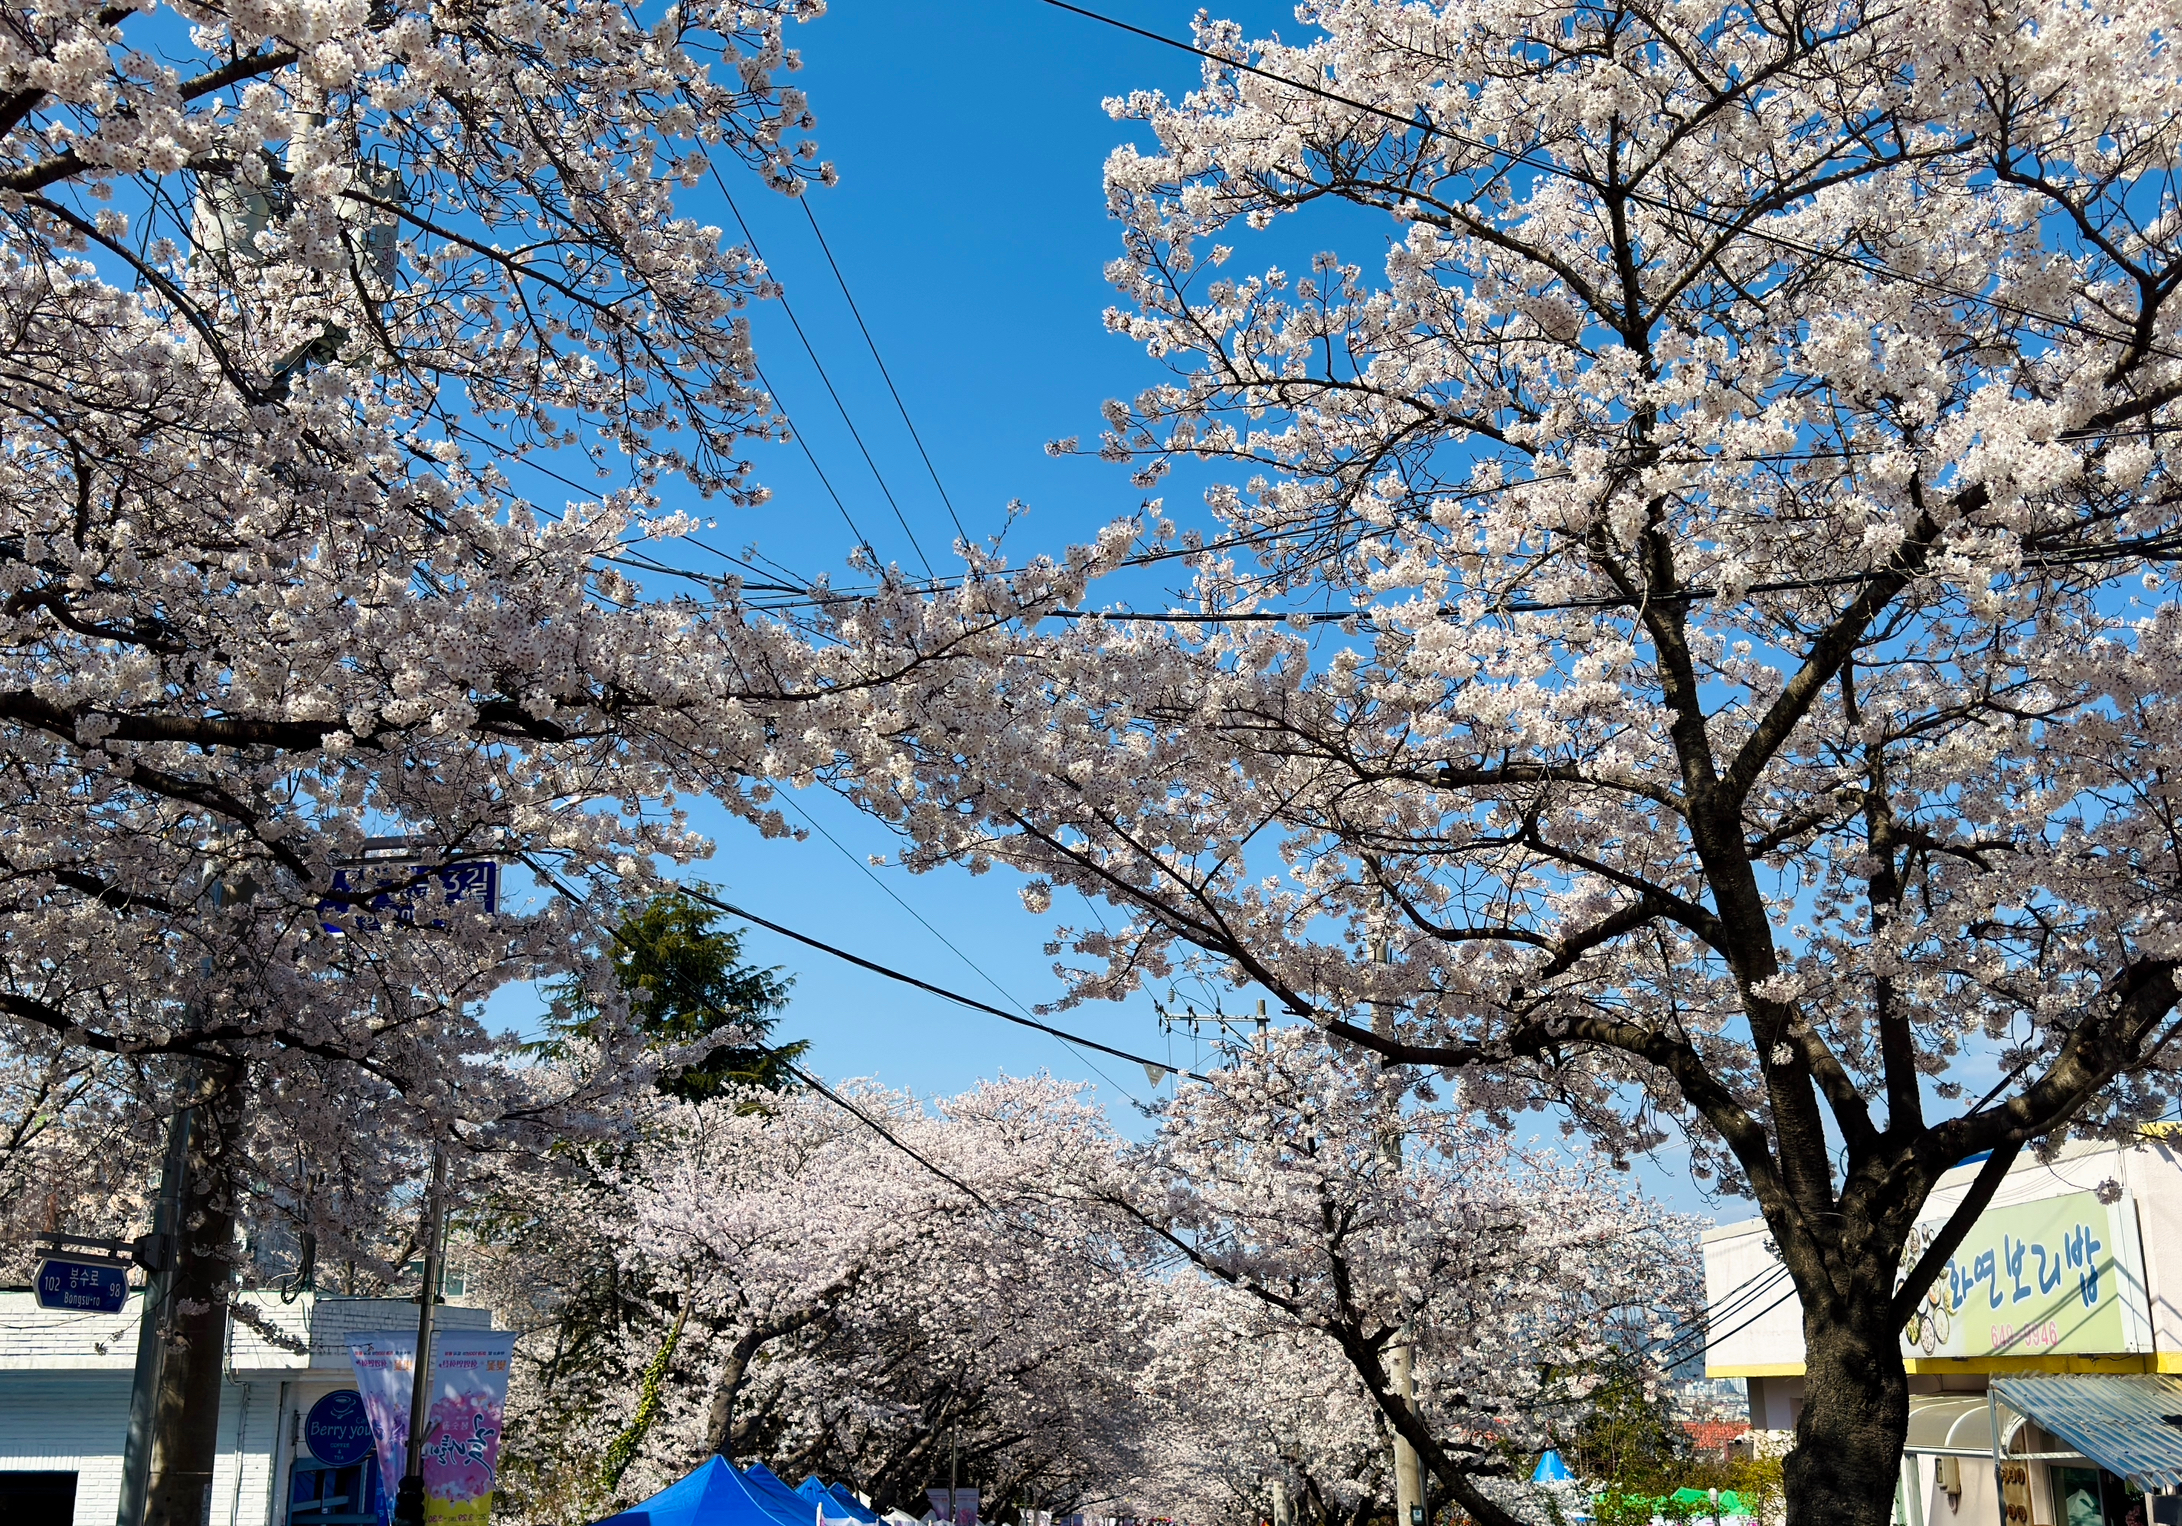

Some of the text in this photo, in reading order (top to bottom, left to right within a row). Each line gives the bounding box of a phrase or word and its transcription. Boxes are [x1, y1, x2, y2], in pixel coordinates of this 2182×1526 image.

[44, 1276, 60, 1292] 102
[69, 1267, 99, 1288] 봉수로
[109, 1282, 121, 1297] 98
[64, 1291, 100, 1307] Bongsu-ro
[311, 1421, 371, 1440] Berry you
